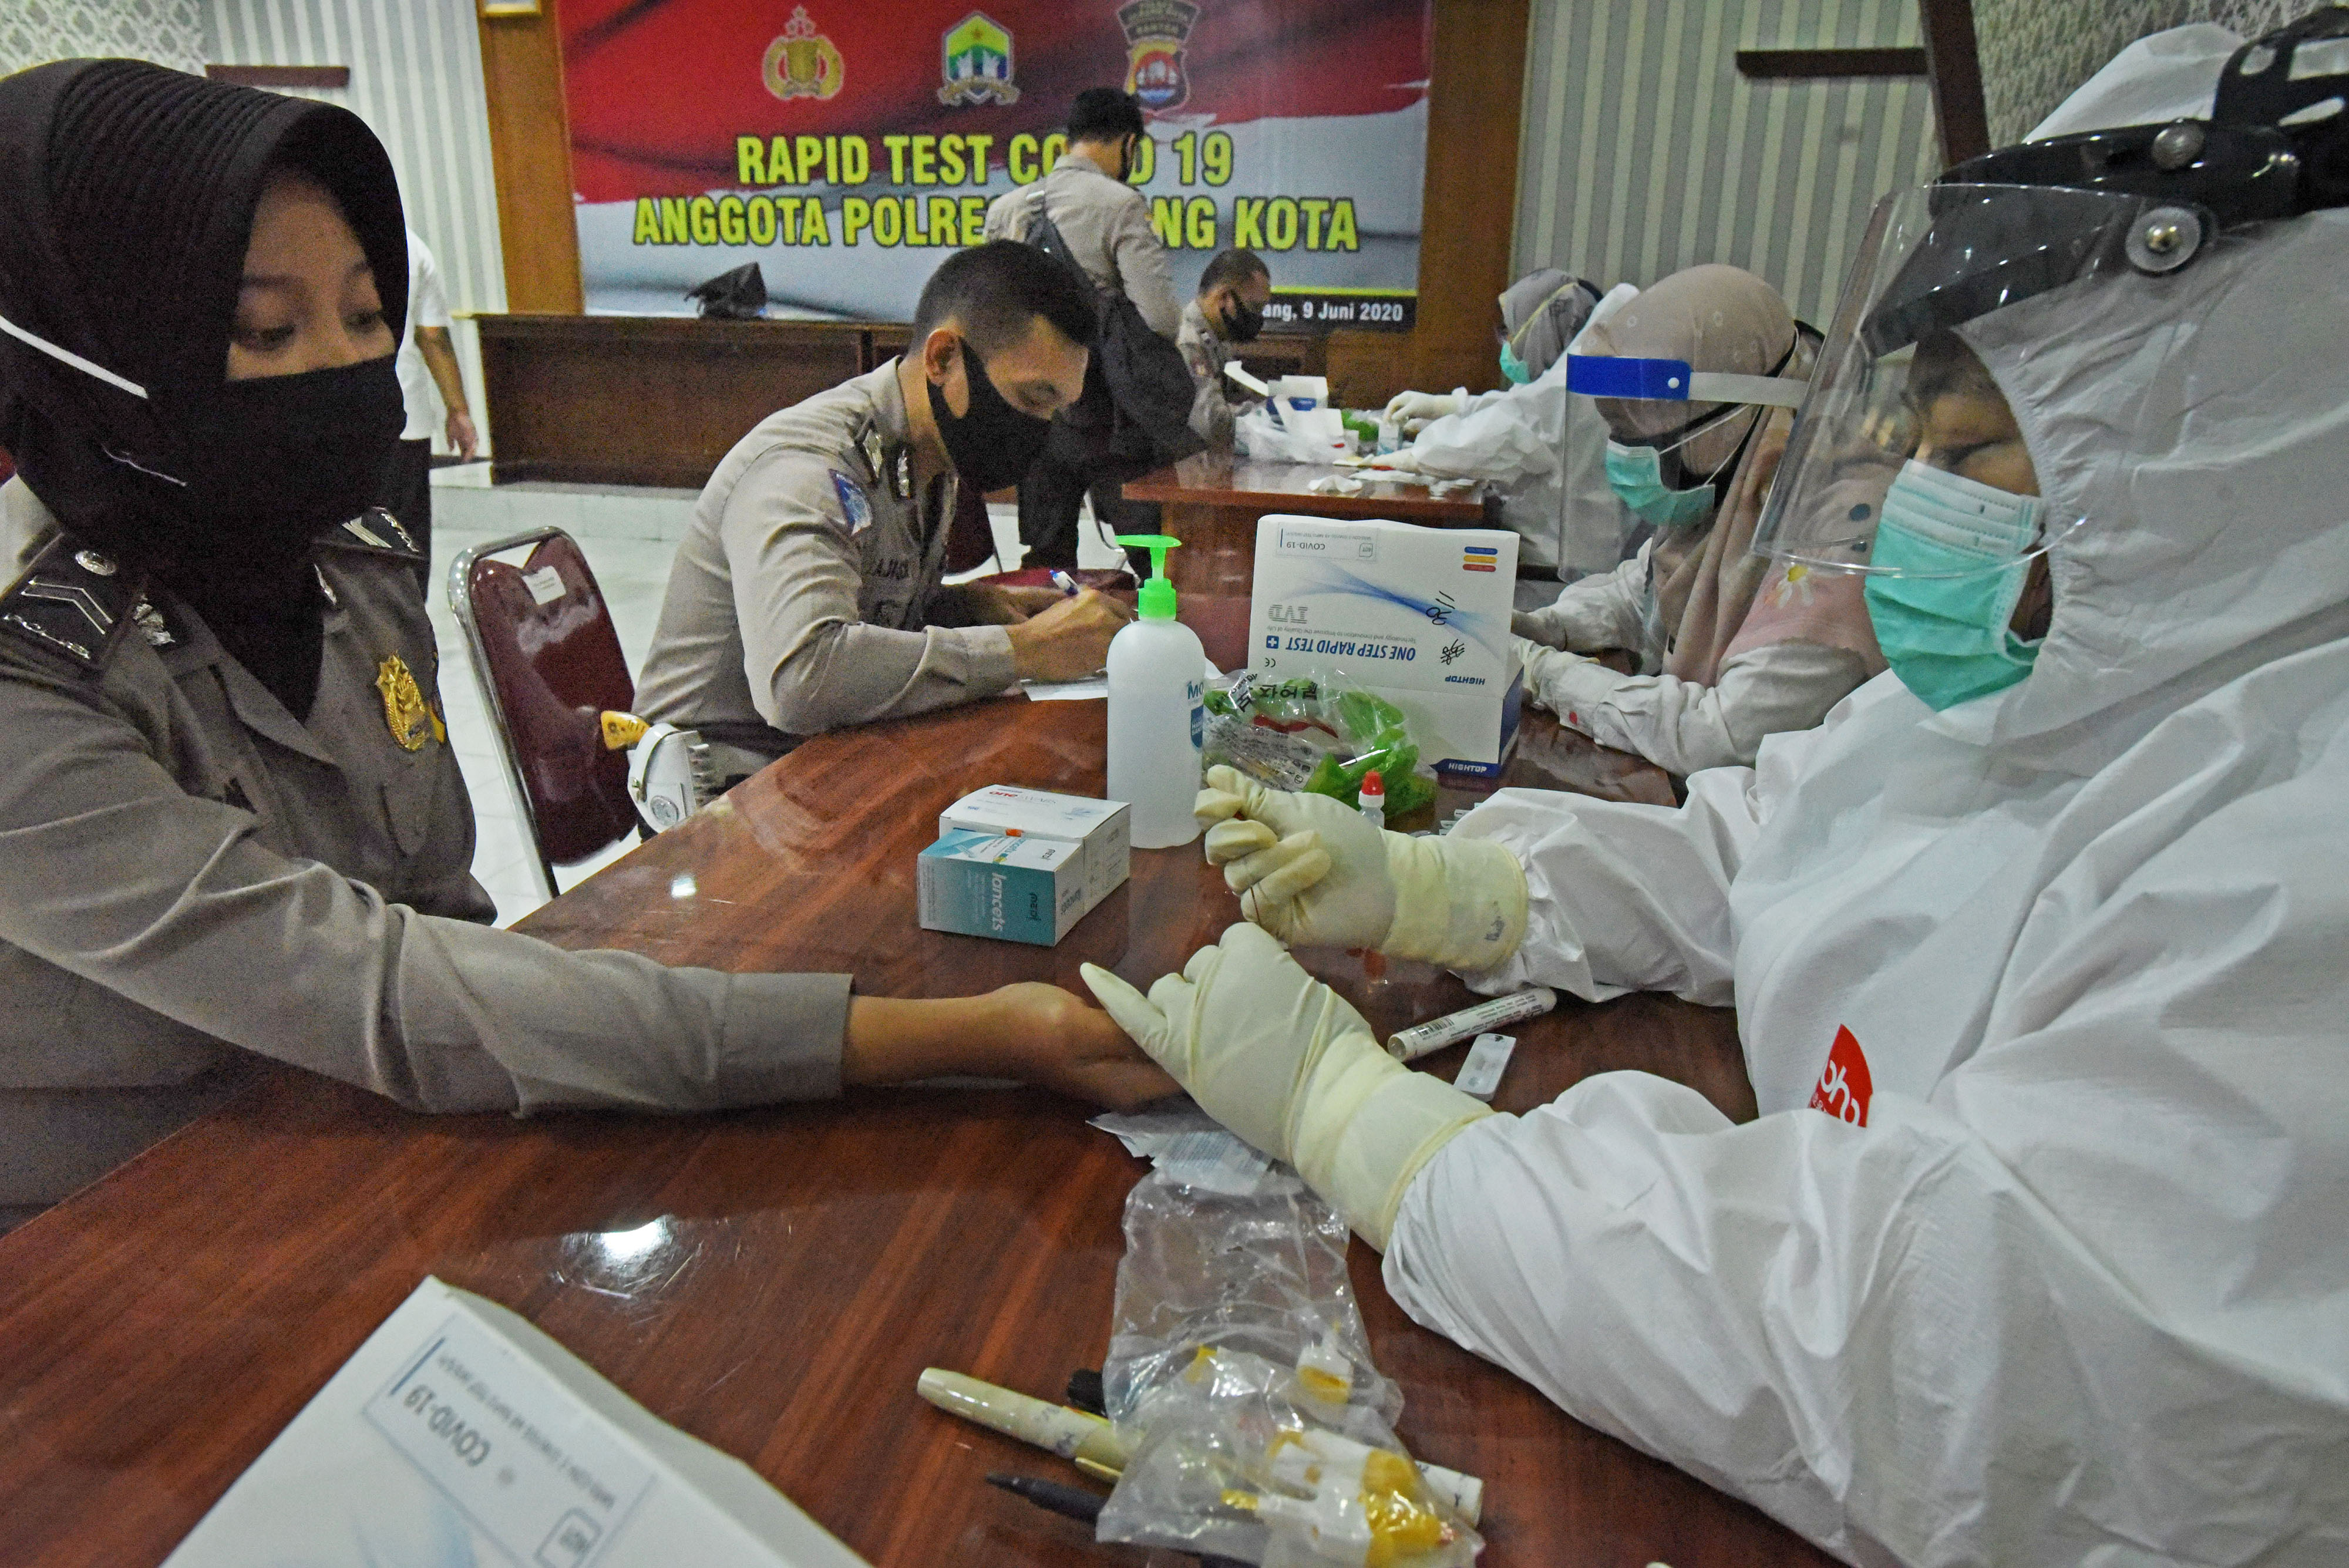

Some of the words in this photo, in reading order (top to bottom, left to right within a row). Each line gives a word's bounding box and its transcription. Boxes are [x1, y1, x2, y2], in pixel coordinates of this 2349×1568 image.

[736, 134, 870, 186] RAPID
[883, 134, 994, 186] TEST
[1008, 133, 1156, 186] COD
[1173, 130, 1234, 186] 19
[633, 196, 831, 246] ANGGOTA
[842, 196, 999, 247] POLRE
[1151, 195, 1217, 249] NG
[1233, 197, 1359, 251] KOTA
[1303, 301, 1314, 319] 9
[1318, 301, 1355, 320] Juni
[1359, 302, 1404, 321] 2020
[1286, 541, 1325, 550] COVID-19
[1268, 604, 1308, 624] IVD
[1285, 637, 1314, 652] TEST
[1316, 640, 1356, 656] RAPID
[1357, 643, 1388, 659] STEP
[1389, 645, 1416, 661] ONE
[1445, 675, 1485, 685] HIGHTOP
[1448, 762, 1488, 773] HIGHTOP
[991, 873, 1007, 932] lancets
[403, 1384, 492, 1467] COVID-19
